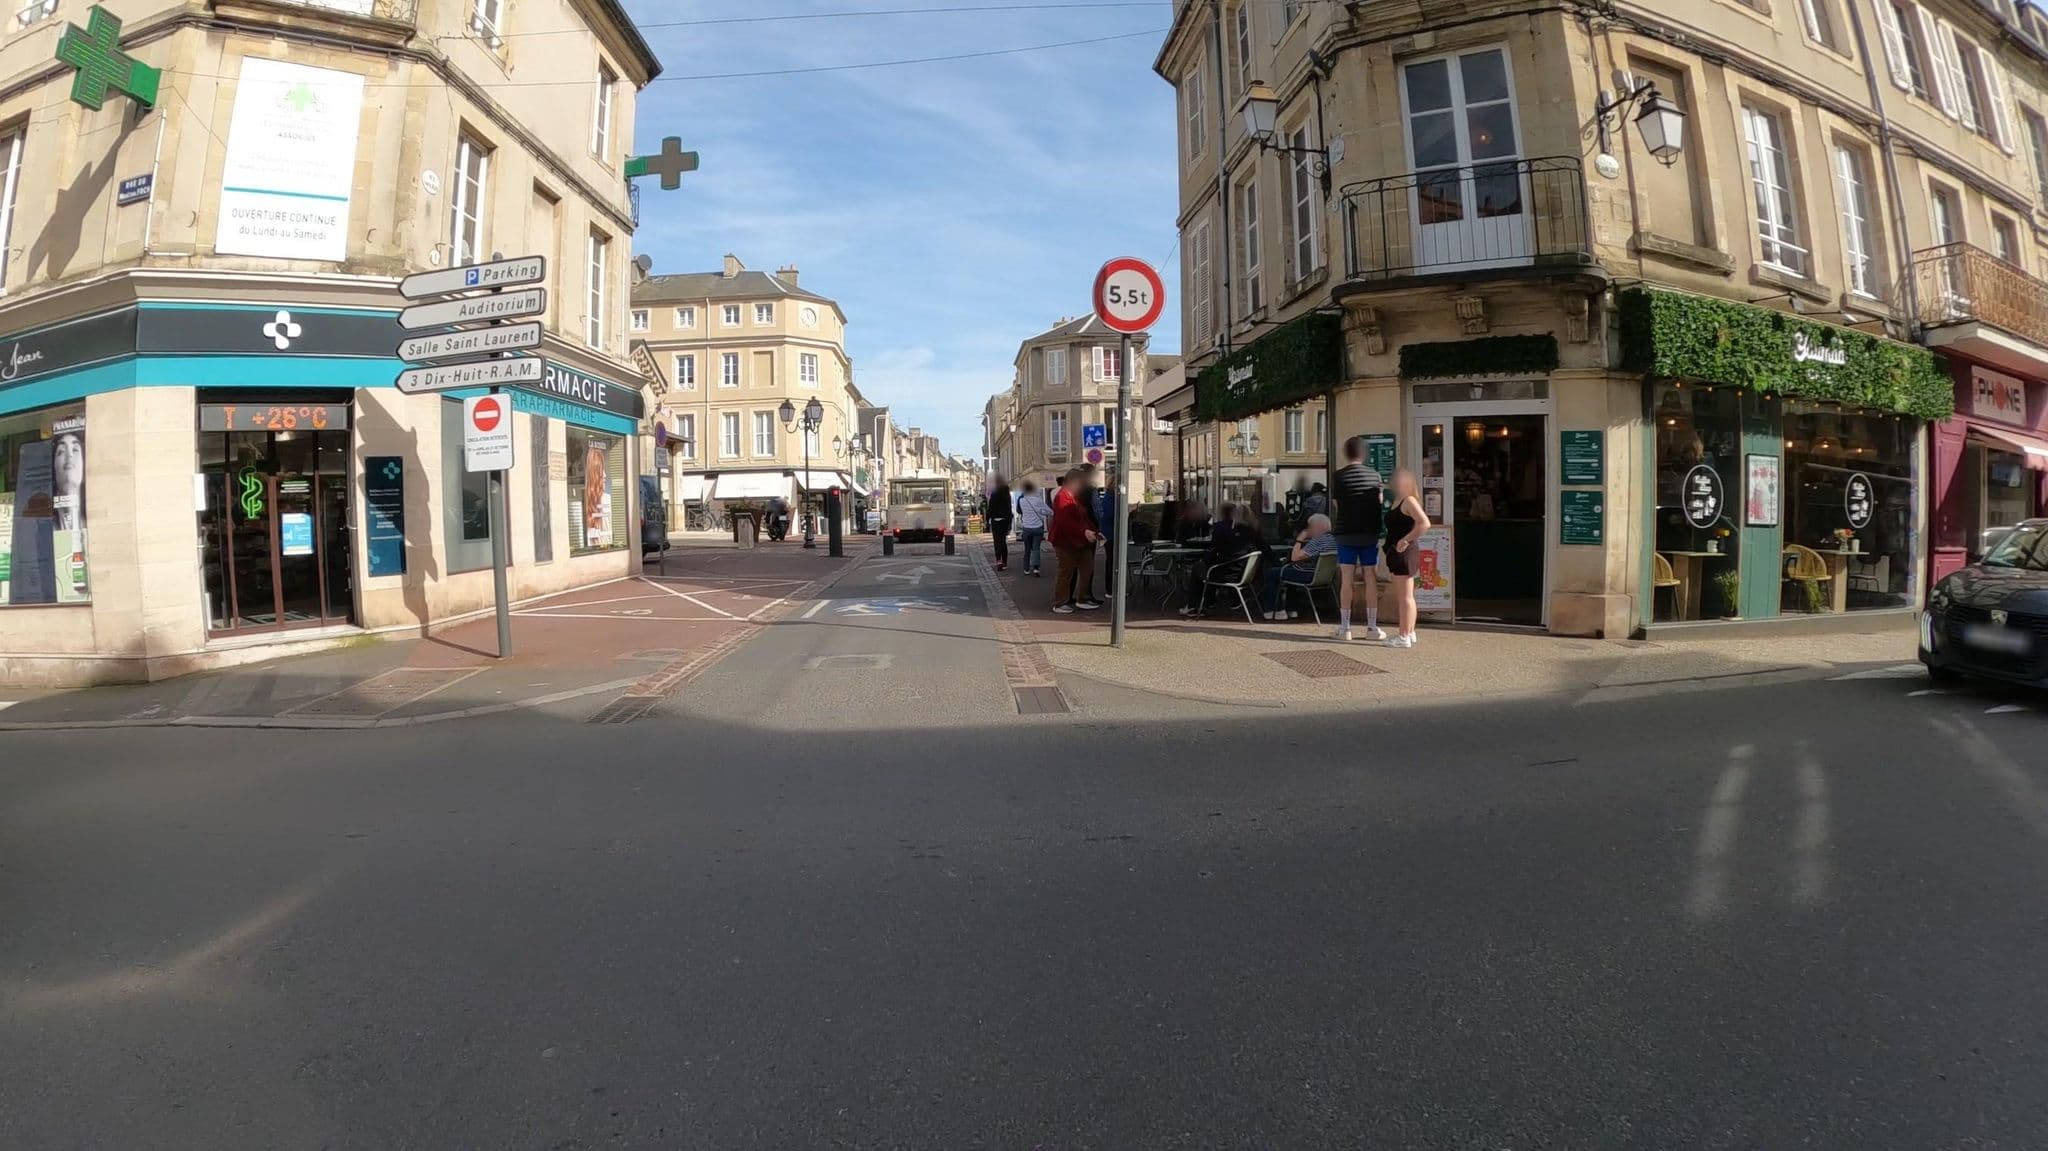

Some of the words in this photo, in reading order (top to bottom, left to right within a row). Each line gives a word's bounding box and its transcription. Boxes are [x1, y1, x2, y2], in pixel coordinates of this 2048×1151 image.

[231, 207, 288, 222] OUVERTURE
[289, 211, 337, 226] CONTINUE
[239, 224, 250, 235] du
[252, 225, 278, 237] Lundi
[279, 230, 291, 238] au
[293, 228, 327, 240] Samedi
[483, 264, 537, 281] Parking
[459, 297, 536, 317] Auditorium
[408, 341, 438, 356] Salle
[444, 337, 478, 351] Saint
[484, 329, 535, 346] Laurent
[1, 342, 44, 379] Jean
[410, 375, 418, 387] 3
[425, 362, 537, 385] Dix-Huit-R.A.M.
[223, 406, 236, 429] T
[504, 390, 596, 423] ARAPHARMACIE
